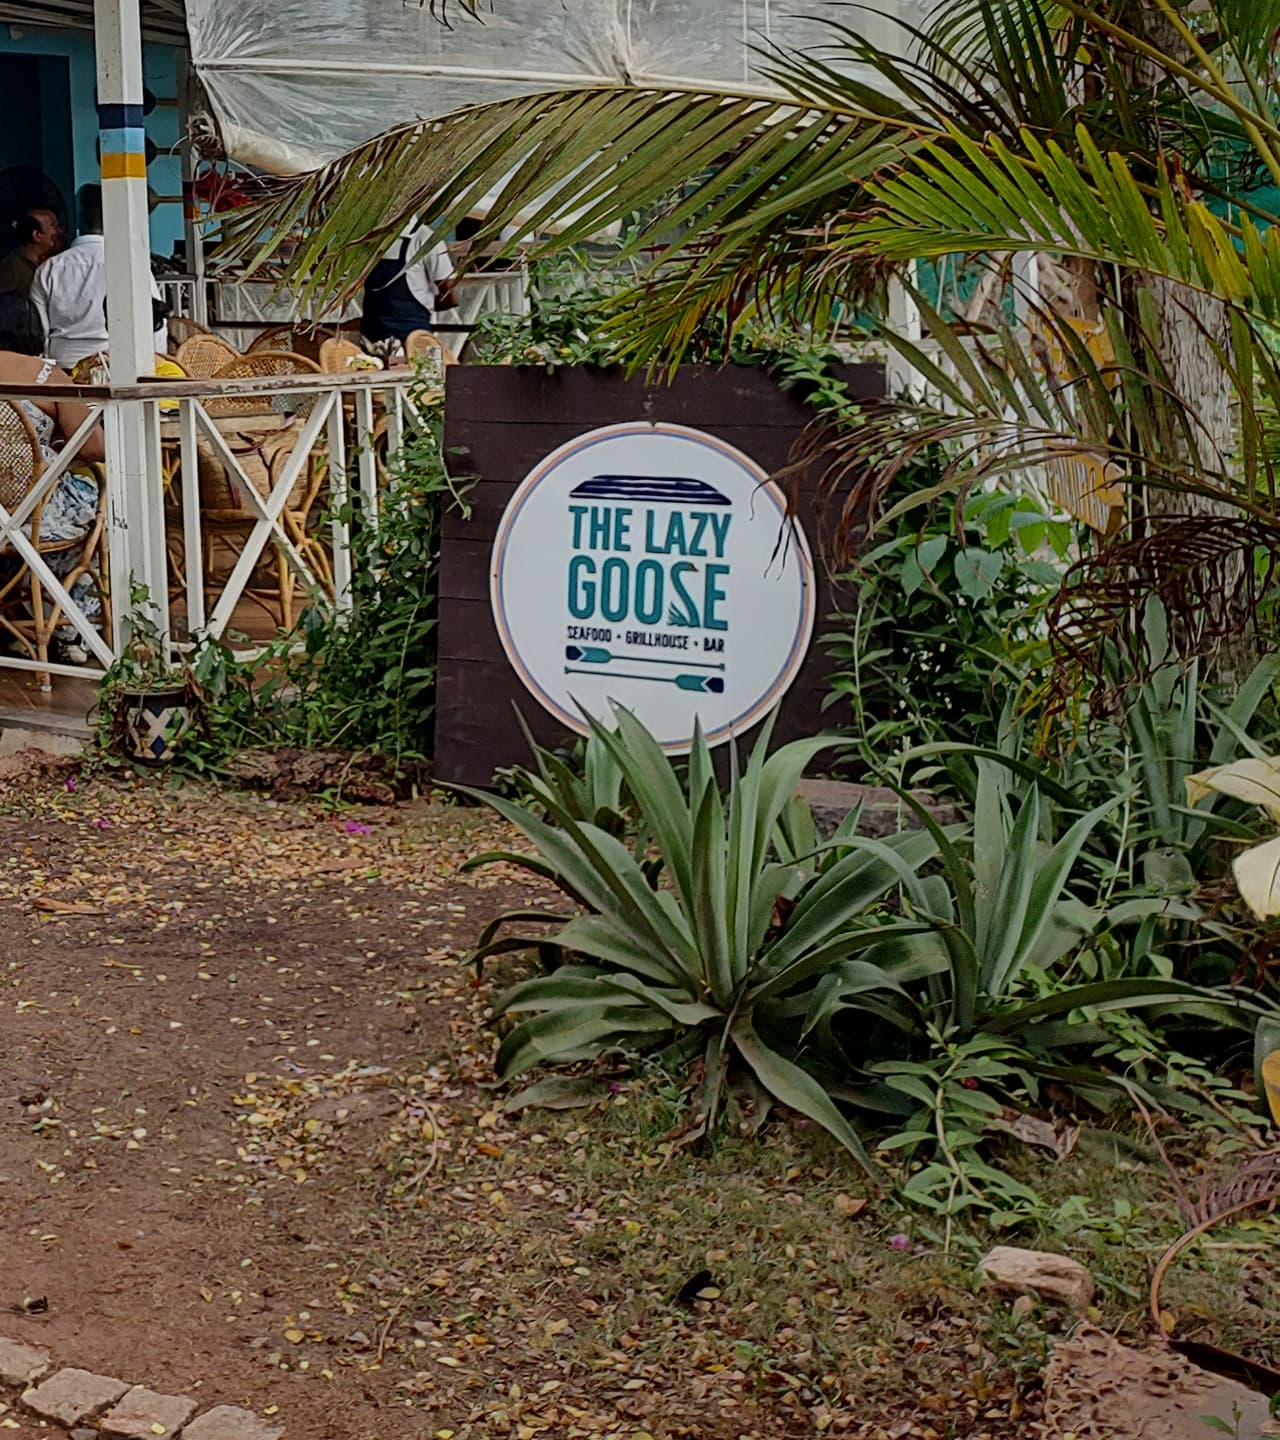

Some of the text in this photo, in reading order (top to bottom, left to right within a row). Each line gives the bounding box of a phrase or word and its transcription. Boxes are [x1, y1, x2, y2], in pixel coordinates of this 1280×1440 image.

[568, 505, 732, 558] THE LAZY
[567, 555, 730, 631] GOOSE
[567, 625, 725, 653] SEAFOOD GRILLHOUSE BAR
